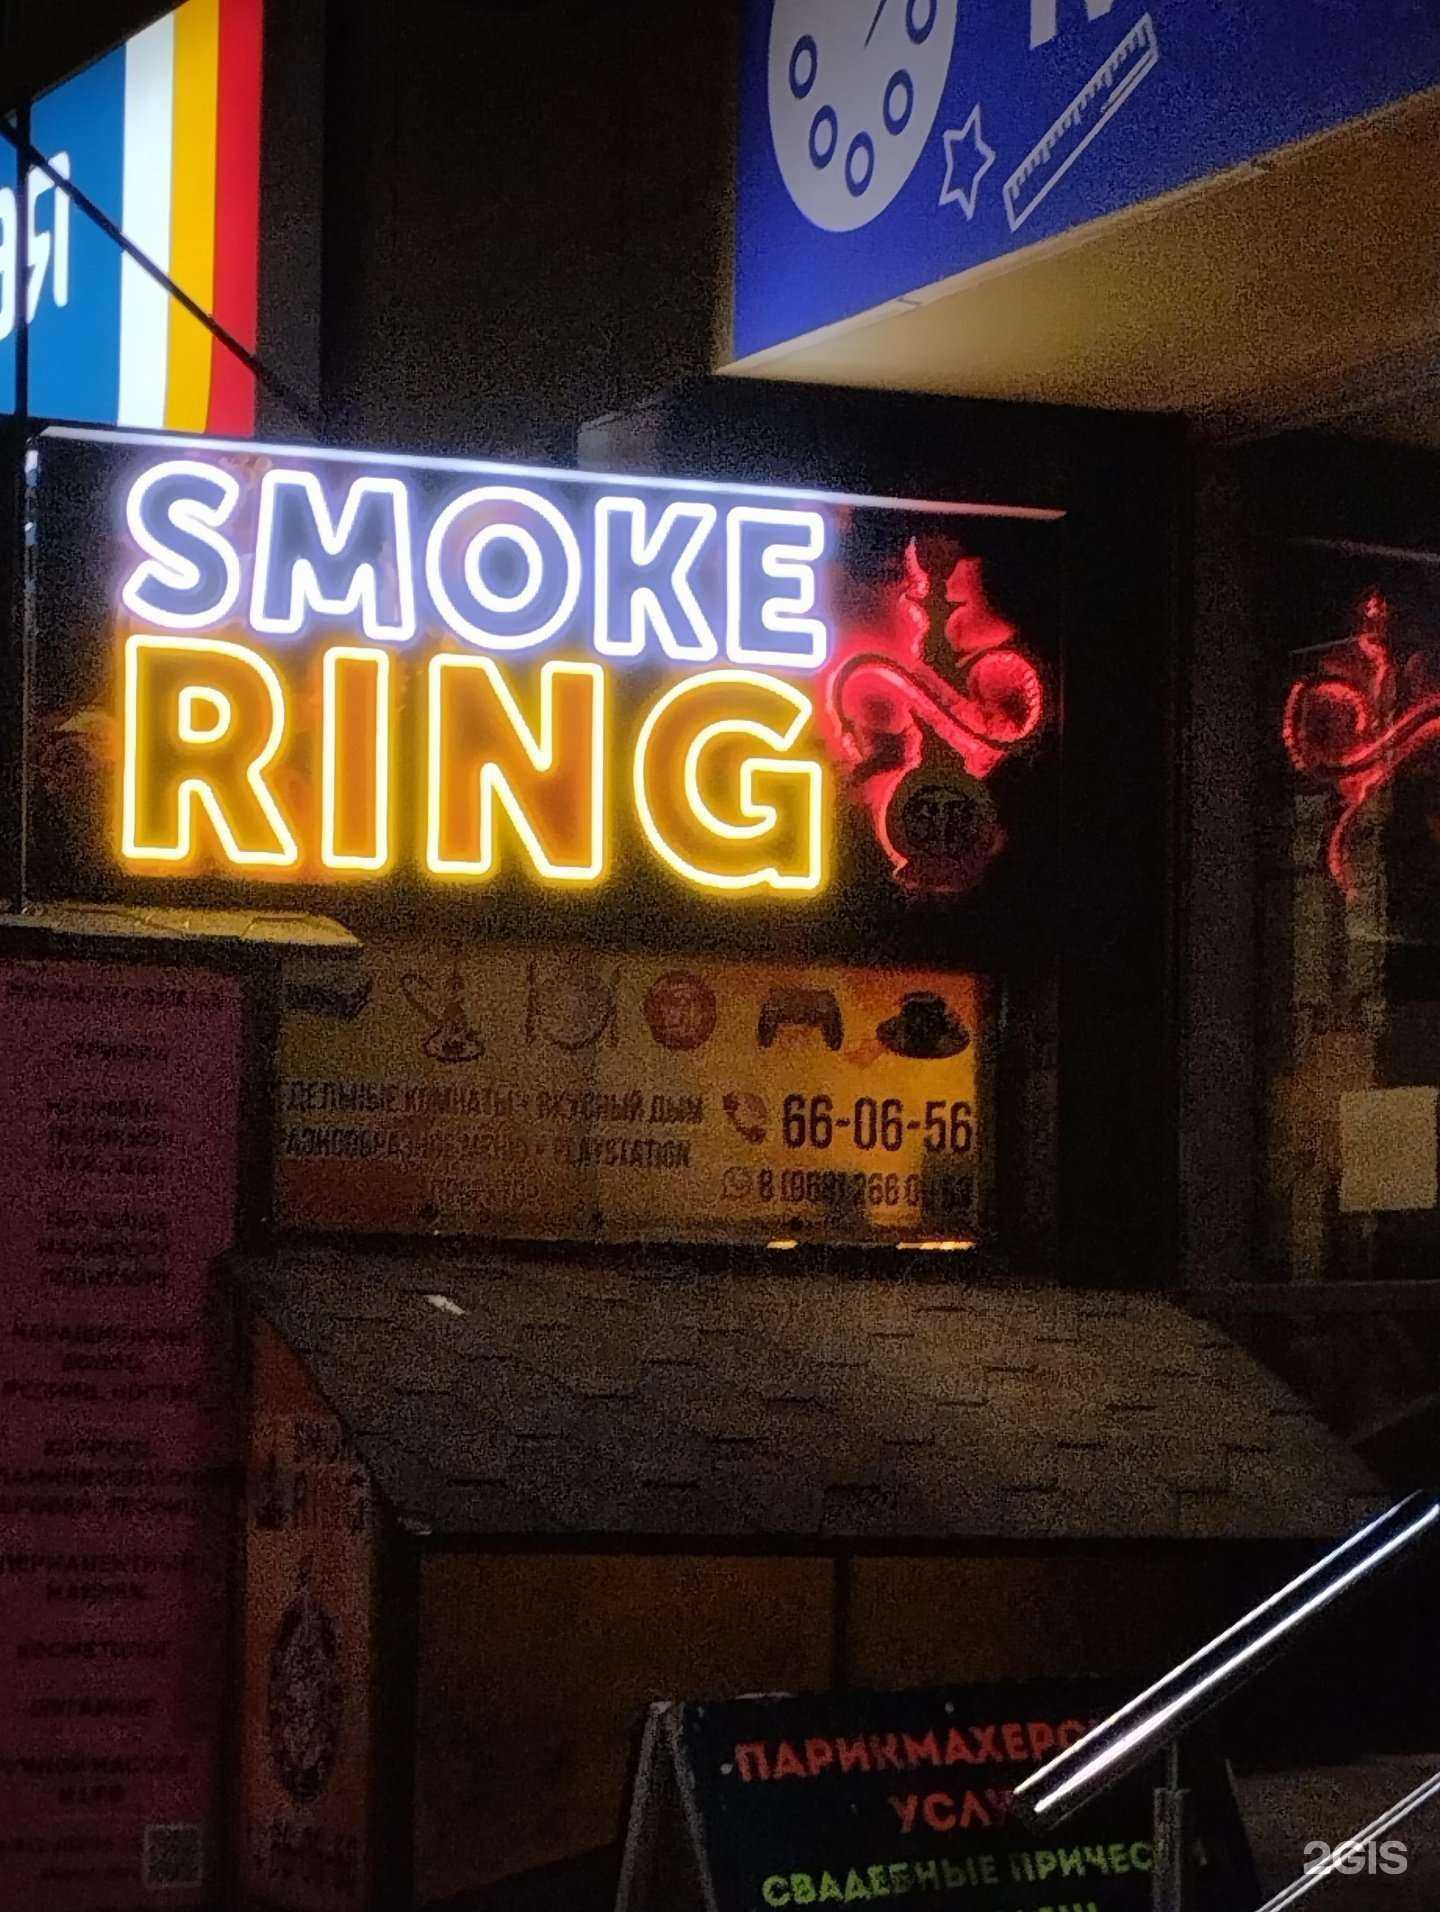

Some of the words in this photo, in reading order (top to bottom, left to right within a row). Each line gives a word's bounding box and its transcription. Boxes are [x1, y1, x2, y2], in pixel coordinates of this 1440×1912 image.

[122, 460, 828, 668] SMOKE
[120, 634, 824, 892] RING
[782, 1092, 973, 1154] 66-06-56
[734, 1718, 1092, 1783] ПАРИКМАХЕРС
[761, 1852, 1000, 1908] СВАДЕБНЫЕ
[1008, 1839, 1154, 1883] ПРИЧЕС
